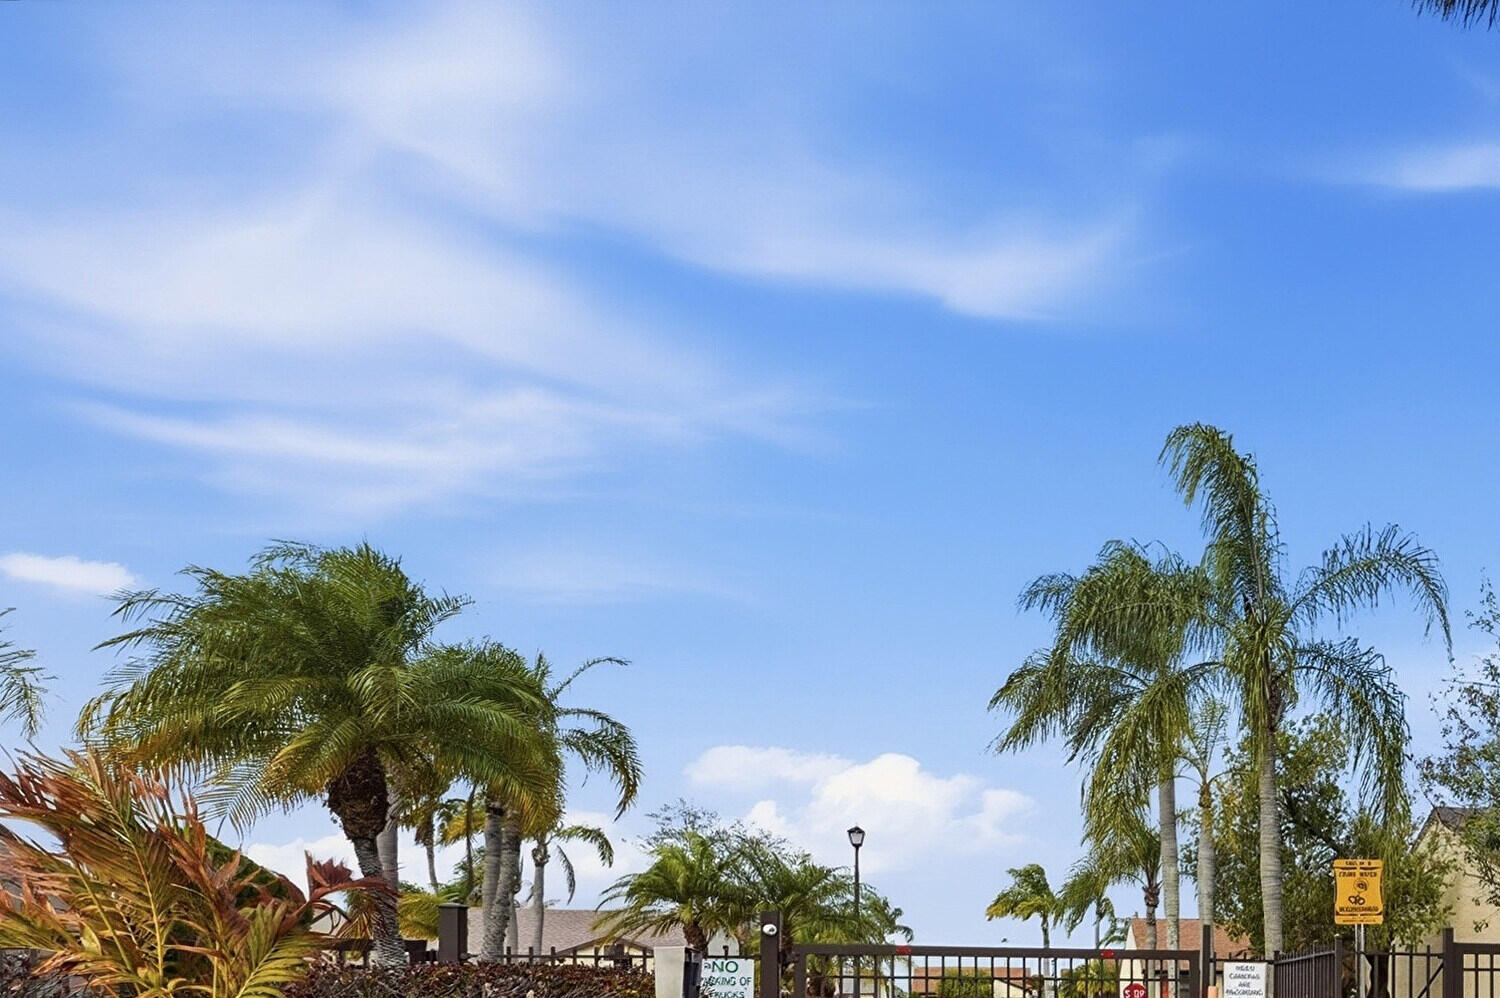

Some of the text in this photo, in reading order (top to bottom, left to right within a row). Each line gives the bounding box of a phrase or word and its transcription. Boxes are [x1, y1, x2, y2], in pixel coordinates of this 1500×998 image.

[712, 961, 739, 973] NO
[740, 976, 752, 986] OF
[1125, 989, 1146, 998] SOP
